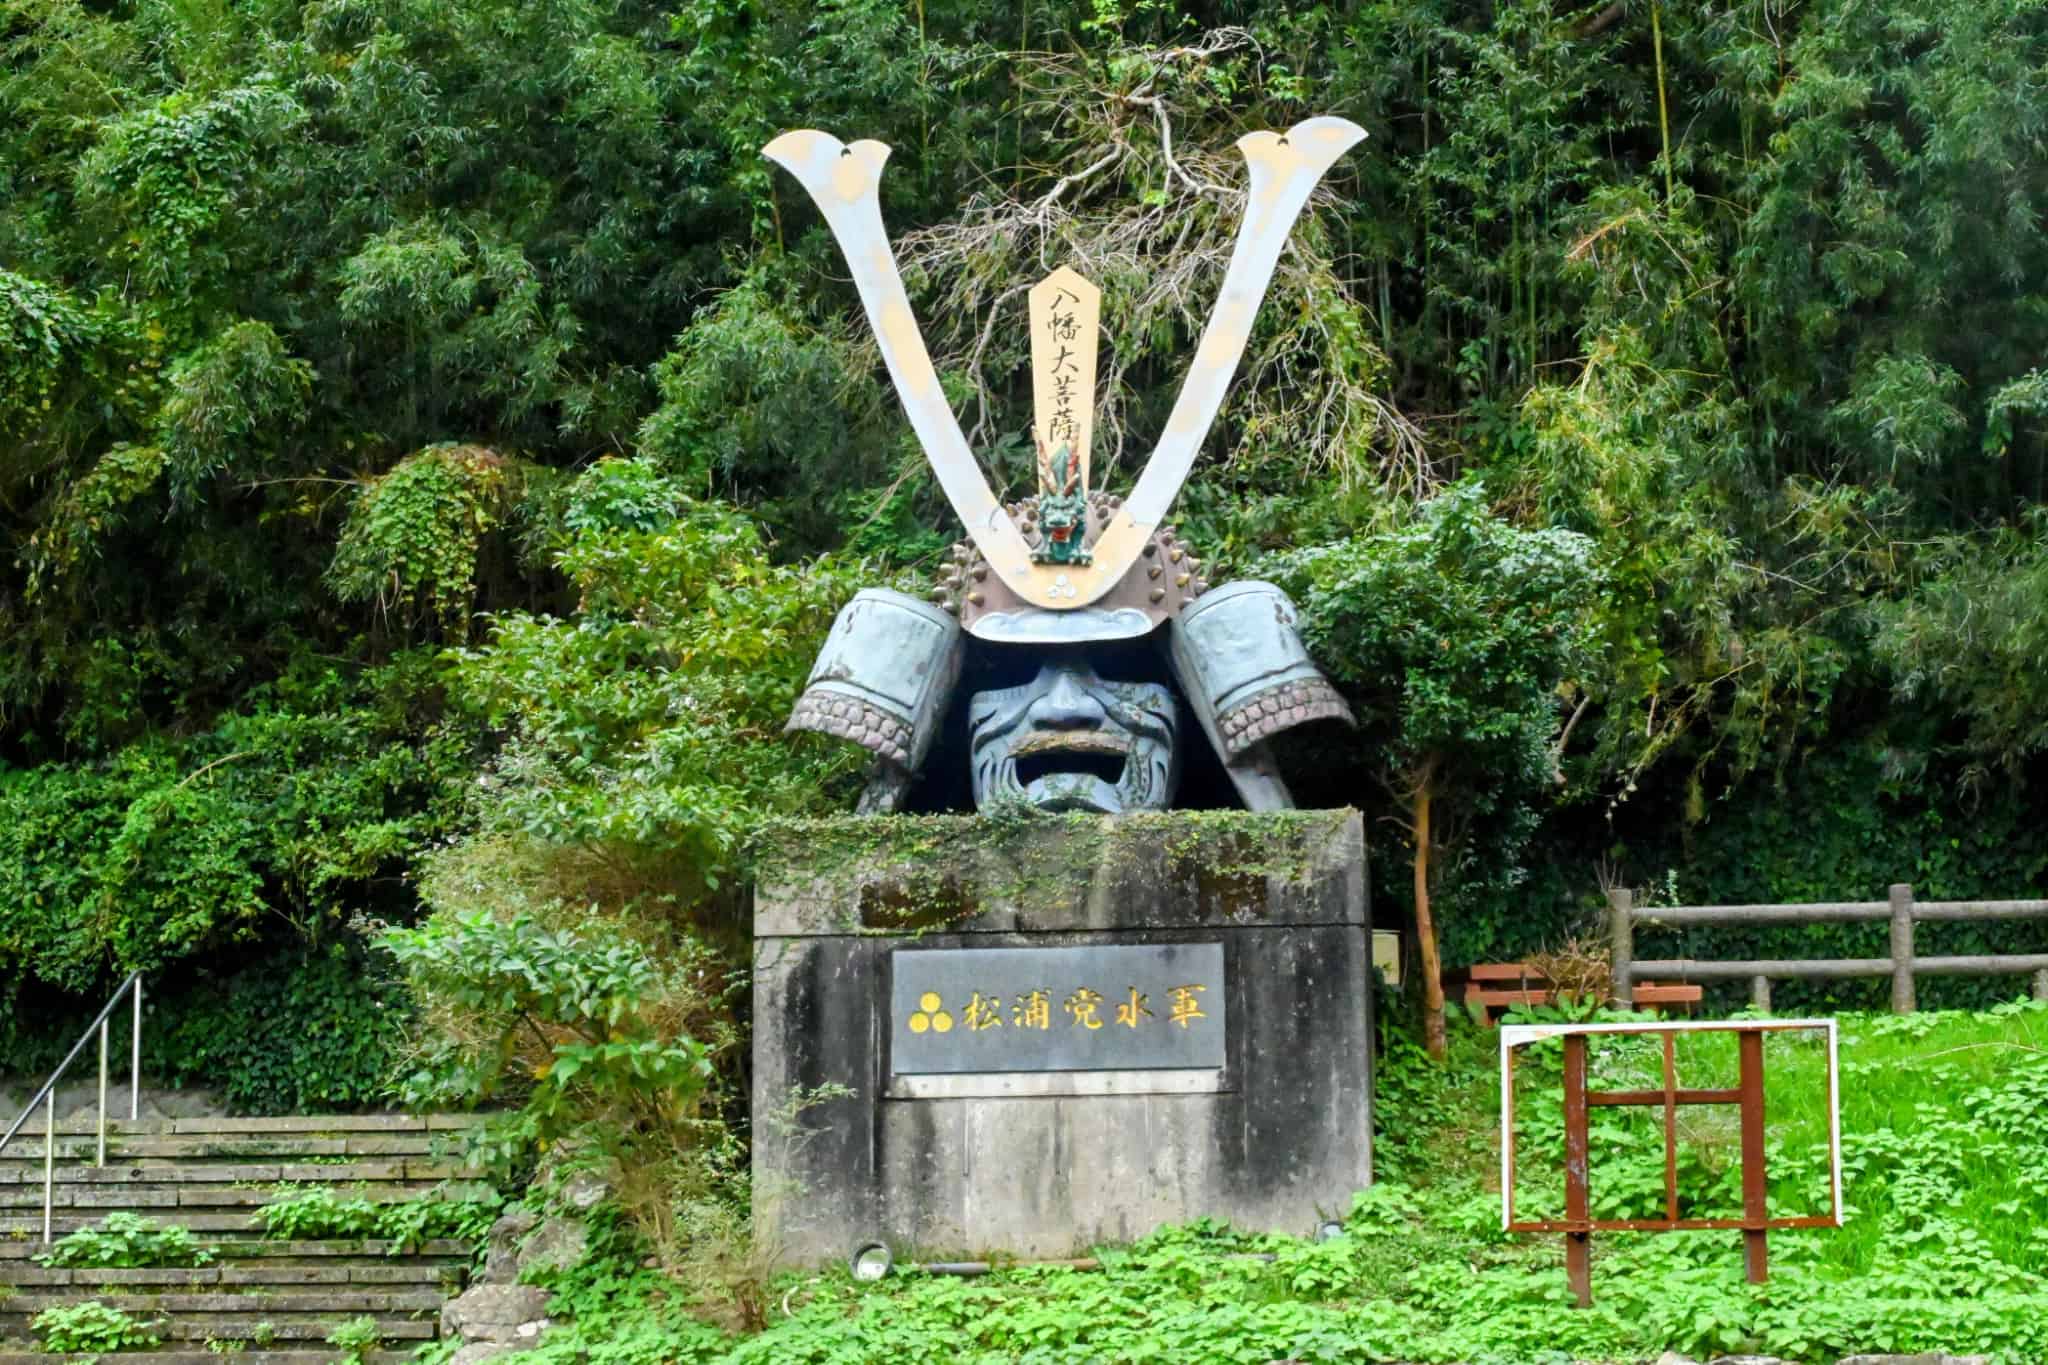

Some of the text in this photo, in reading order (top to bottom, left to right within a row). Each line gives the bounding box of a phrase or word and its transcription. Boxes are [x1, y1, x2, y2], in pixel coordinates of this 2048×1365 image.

[1047, 287, 1082, 443] 八幡大菩薩
[962, 984, 1208, 1031] 松浦党水軍
